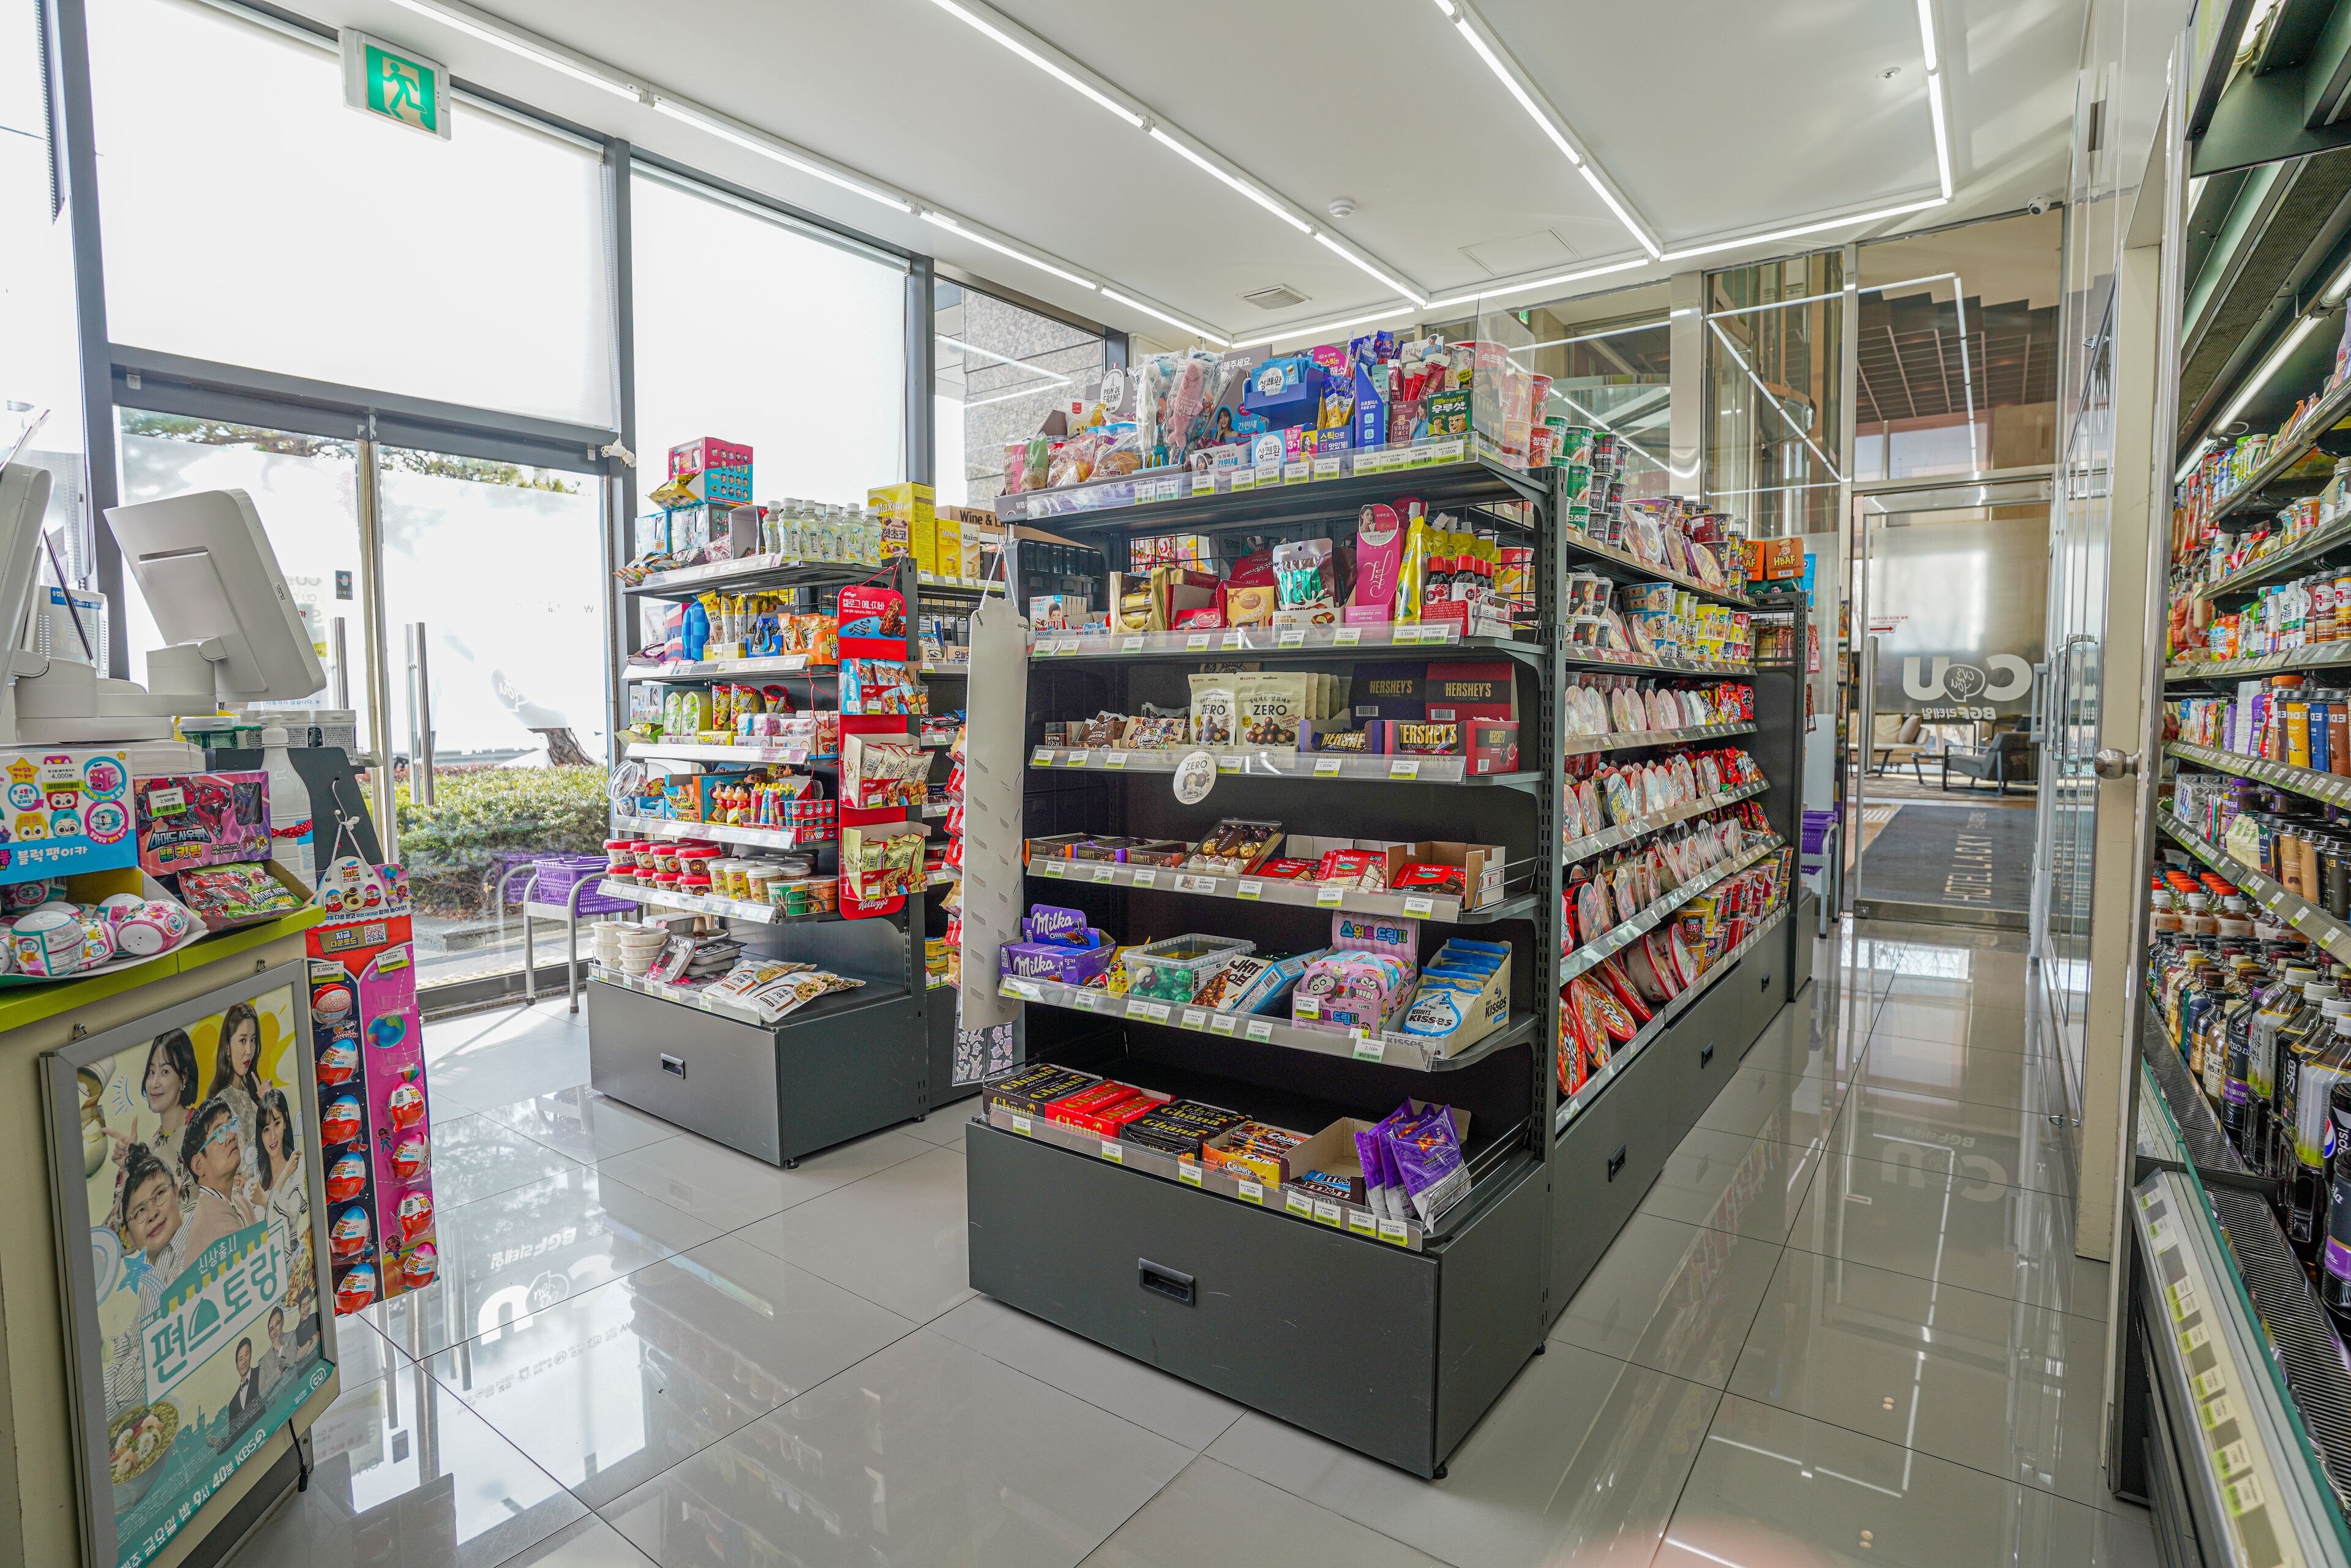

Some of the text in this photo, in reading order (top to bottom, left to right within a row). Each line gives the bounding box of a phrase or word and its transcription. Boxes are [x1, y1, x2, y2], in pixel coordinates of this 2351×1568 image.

[1259, 375, 1283, 390] 상쾌환
[1431, 402, 1467, 413] 우루샷
[1238, 419, 1257, 430] 간만세
[1320, 432, 1344, 442] 스틱으로
[1288, 440, 1300, 449] 3+1
[1320, 441, 1348, 452] 더 맛있게!
[1257, 447, 1280, 459] 상쾌환
[877, 499, 904, 514] Maxim
[959, 509, 992, 525] Wine &
[882, 528, 906, 541] 핫초코
[942, 530, 959, 539] Maxim
[1774, 554, 1796, 566] HBAF
[842, 599, 885, 610] 켈로그 에너지바
[1369, 680, 1412, 694] HERSHEY'S
[1445, 683, 1491, 697] HERSHEY'S
[1201, 705, 1226, 715] ZERO
[1253, 705, 1287, 716] ZERO
[1489, 730, 1505, 743] HERSHEY'S
[1185, 760, 1207, 771] ZERO
[175, 844, 202, 860] 키링
[1030, 844, 1046, 853] HERSHEY'S
[1078, 849, 1095, 858] HERSHEY'S
[1949, 833, 1993, 869] LACKY
[1131, 853, 1150, 863] HERSHEY'S
[1943, 872, 1993, 904] HOTEL
[858, 898, 889, 910] Kellogg's
[1031, 910, 1074, 936] Milka
[1340, 920, 1375, 940] 스위트
[330, 937, 358, 948] 다운로드
[1013, 955, 1056, 977] Milka
[1485, 996, 1507, 1019] KISSES
[1408, 1015, 1453, 1026] KISSES
[1386, 1037, 1424, 1048] KISSES
[1000, 1067, 1059, 1090] Ghana
[1030, 1075, 1089, 1099] Ghana
[1065, 1085, 1123, 1108] Ghana
[1101, 1092, 1119, 1102] Chocolate
[992, 1096, 1034, 1119] Ghana
[1132, 1105, 1150, 1115] Chocolate
[1160, 1107, 1221, 1127] Ghana
[1055, 1114, 1101, 1139] Ghana
[1142, 1119, 1200, 1138] Ghana
[1226, 1161, 1253, 1175] CRUNKY
[197, 1234, 238, 1276] 신상출시
[142, 1461, 235, 1558] 금요일 밤 9시 40분
